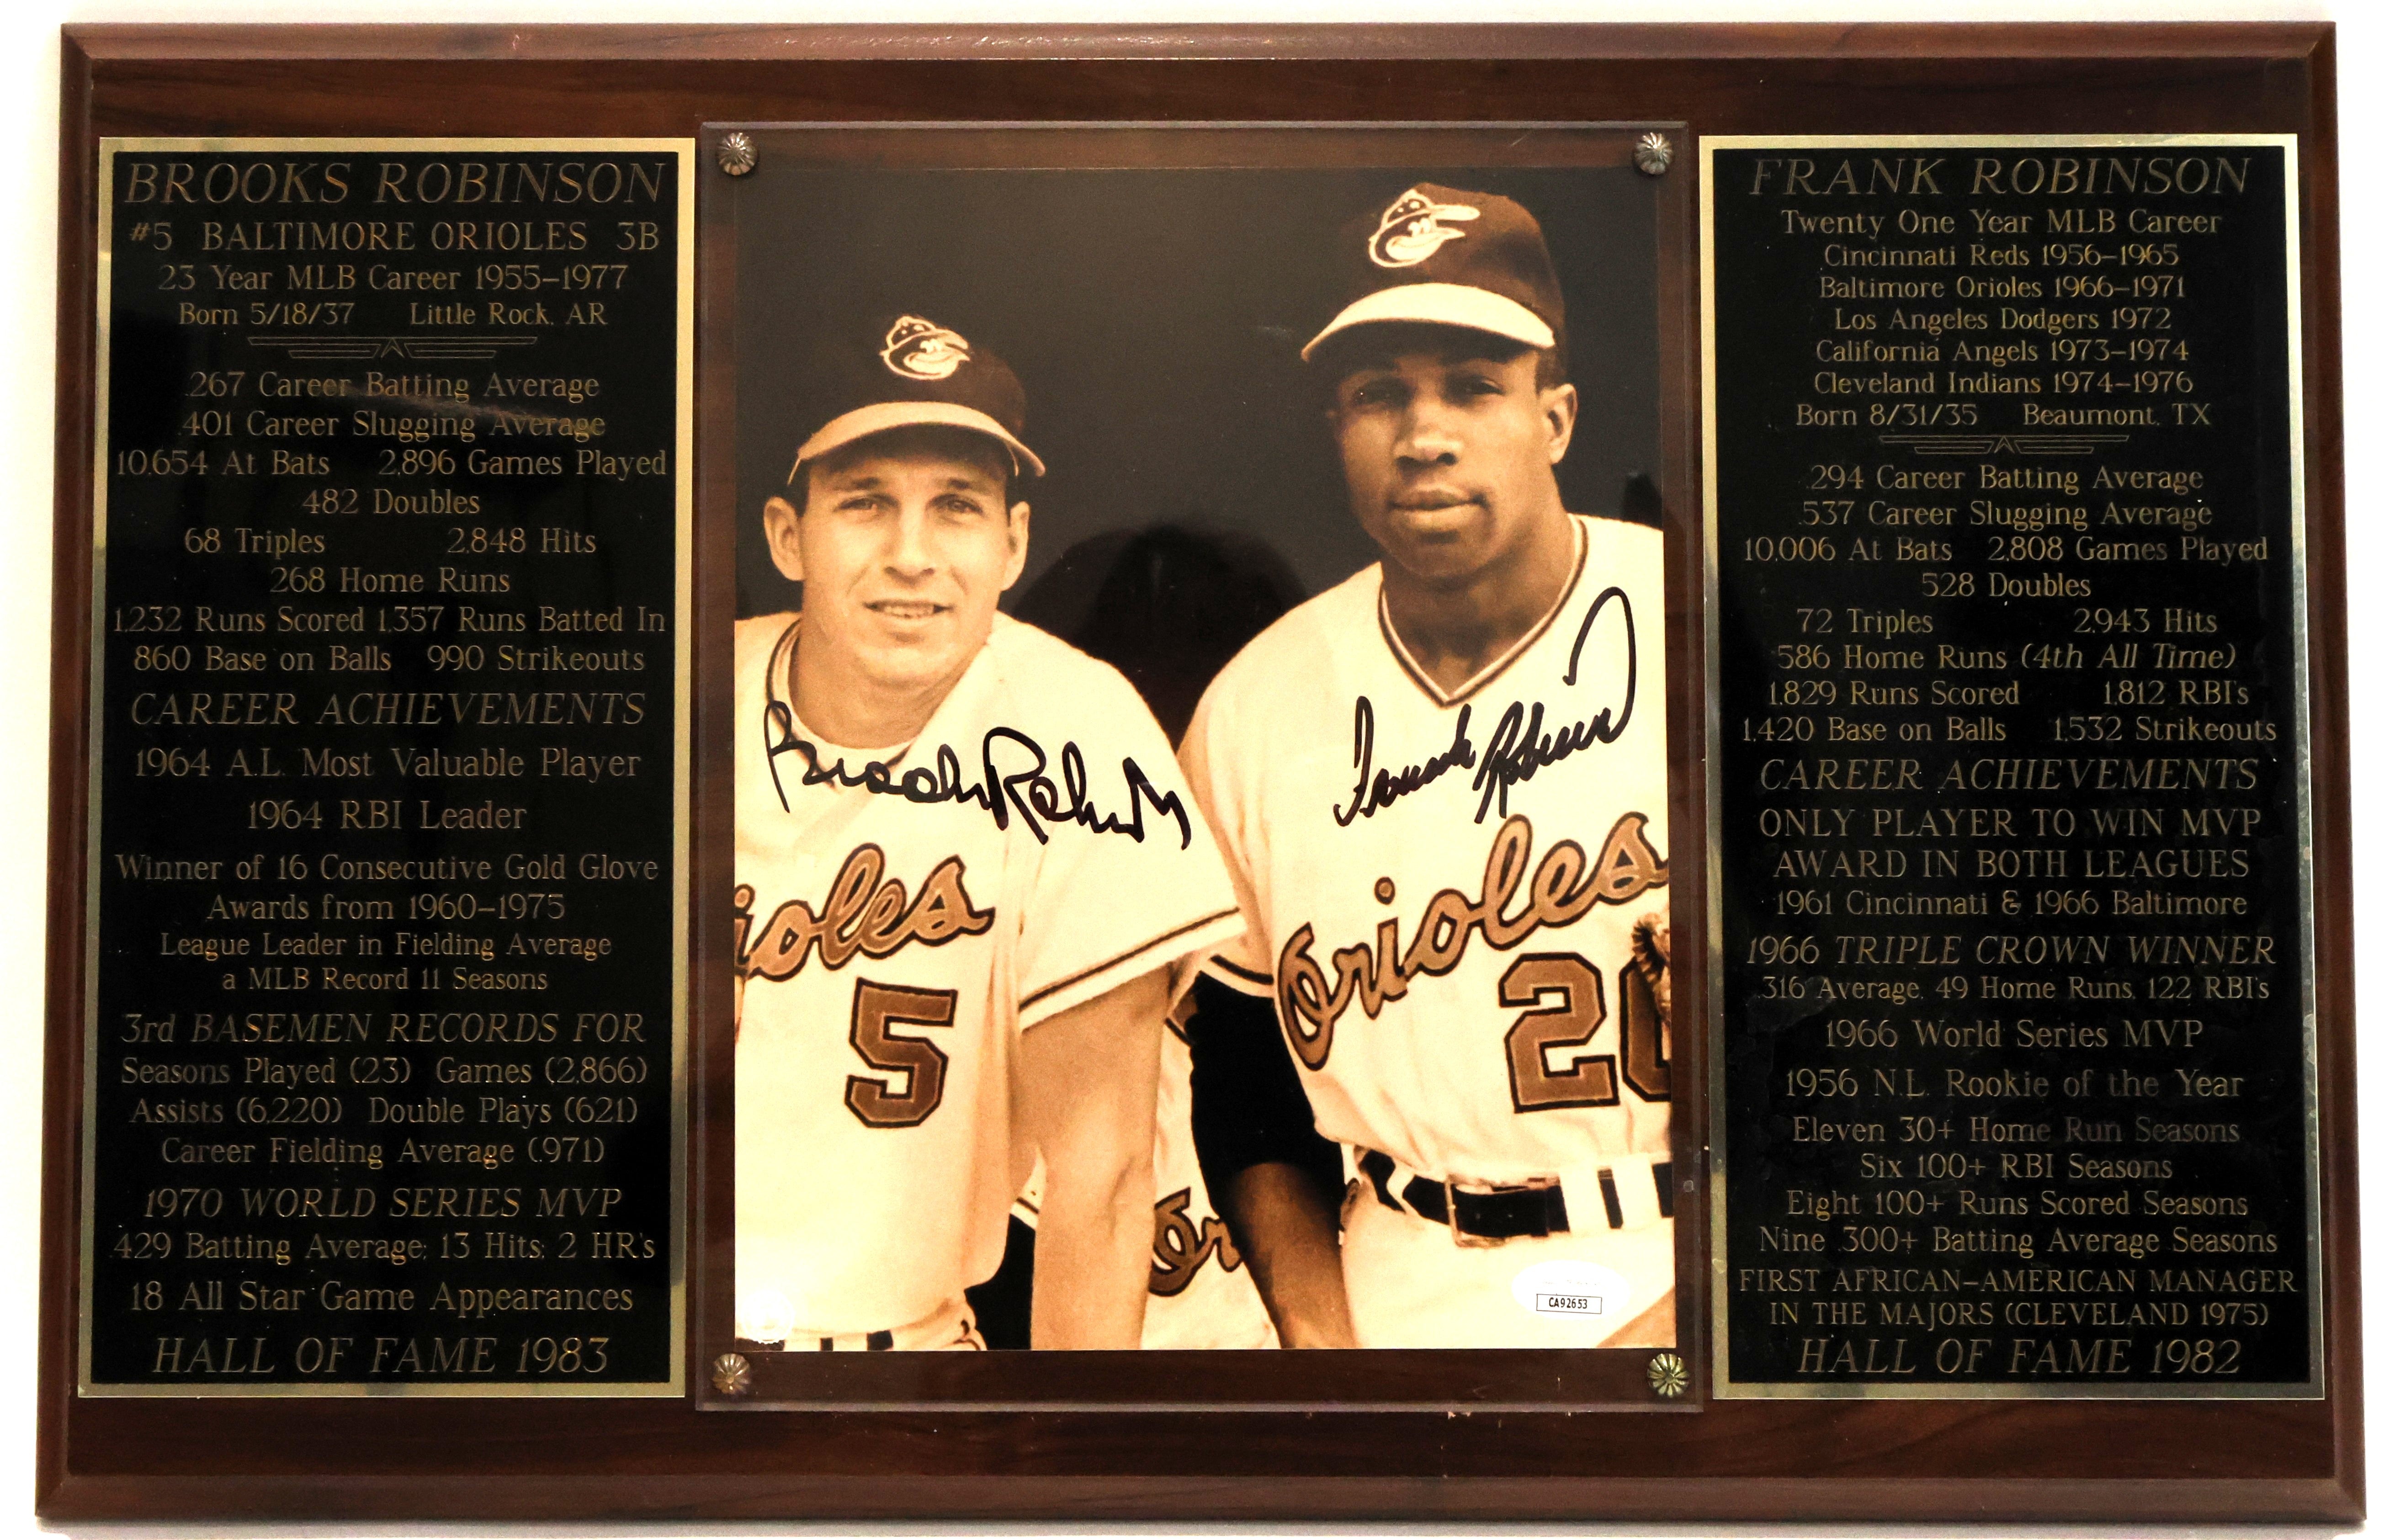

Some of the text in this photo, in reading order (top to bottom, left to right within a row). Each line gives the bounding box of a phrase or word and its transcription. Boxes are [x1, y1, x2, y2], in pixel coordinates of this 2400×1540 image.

[124, 162, 666, 204] BROOKS ROBINSON
[1749, 157, 2251, 196] FRANK ROBINSON
[129, 221, 659, 251] #5 BALTIMORE ORIOLES 3B
[1780, 208, 2222, 240] Twenty One Year MLB Career
[1824, 244, 1956, 267] Cincinnati
[1970, 244, 2030, 266] Reds
[158, 264, 196, 291] 23
[209, 264, 273, 290] Year
[287, 264, 356, 290] MLB
[368, 264, 462, 290] Career
[1820, 276, 1945, 299] Baltimore
[1956, 275, 2043, 298] Orioles
[1835, 307, 2172, 336] Los Angeles Dodgers 1972
[1816, 339, 1940, 362] California
[1952, 339, 2039, 368] Angels
[1814, 371, 1935, 394] Cleveland
[1948, 371, 2042, 394] Indians
[302, 488, 481, 515] 482 Doubles
[270, 566, 511, 593] 268 Home Runs
[1922, 572, 2092, 597] 528 Doubles
[133, 644, 645, 671] 860 Base on Balls 990 Strikeouts
[1778, 643, 2236, 670] 586 Home Runs (4th All Time)
[131, 692, 645, 725] CAREER ACHIEVEMENTS
[136, 747, 211, 777] 1964
[302, 747, 374, 777] Most
[390, 747, 525, 777] Valuable
[540, 747, 642, 784] Player
[1760, 758, 2259, 791] CAREER ACHIEVEMENTS
[1759, 808, 2261, 838] ONLY PLAYER TO WIN MVP
[114, 853, 658, 882] Winner of 16 Consecutive Gold Glove
[1773, 849, 2250, 878] AWARD IN BOTH LEAGUES
[1777, 889, 2247, 916] 1961 Cincinnati & 1966 Baltimore
[160, 931, 611, 962] League Leader in Fielding Average
[1278, 811, 1669, 1071] Orioles
[222, 966, 549, 990] a MLB Record 11 Seasons
[121, 1012, 647, 1043] 3rd BASEMEN RECORDS FOR
[1826, 1019, 2204, 1048] 1966 World Series MVP
[844, 977, 958, 1128] 5
[1786, 1067, 1859, 1097] 1956
[1945, 1068, 2050, 1098] Rookie
[2063, 1068, 2094, 1097] of
[2109, 1068, 2159, 1097] the
[2174, 1068, 2245, 1097] Year
[1860, 1152, 2173, 1181] Six 100+ RBI Seasons
[143, 1187, 622, 1218] 1970 WORLD SERIES MVP
[1786, 1189, 2249, 1221] Eight 100+ Runs Scored Seasons
[1739, 1268, 1821, 1292] FIRST
[2148, 1269, 2299, 1293] MANAGER
[131, 1280, 633, 1319] 18 All Star Game Appearances
[1549, 1297, 1588, 1310] CA92653
[1770, 1301, 2269, 1332] IN THE MAJORS (CLEVELAND 1975)
[152, 1336, 610, 1374] HALL OF FAME 1983
[1797, 1338, 2241, 1374] HALL OF FAME 1982
